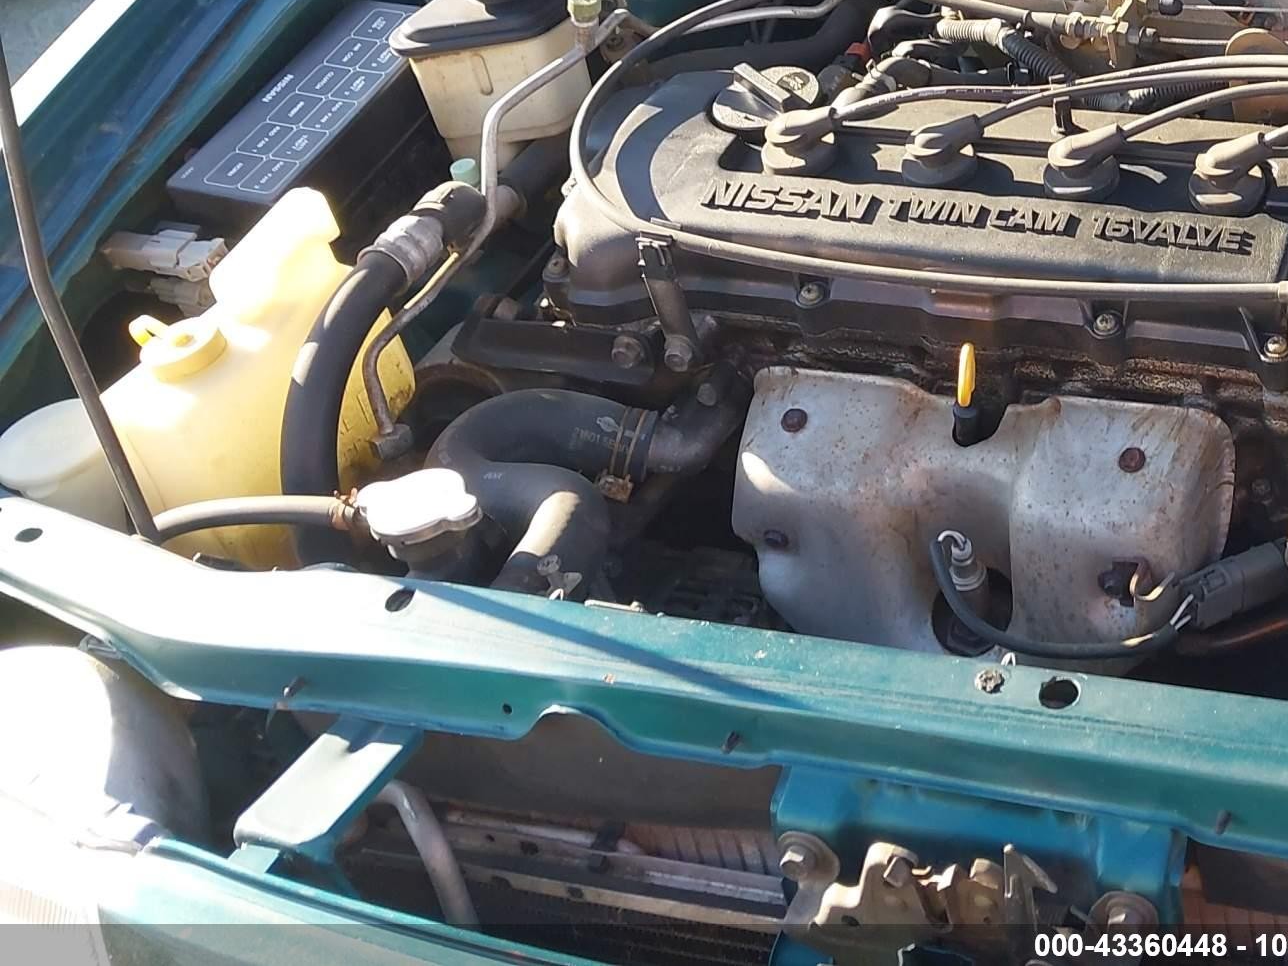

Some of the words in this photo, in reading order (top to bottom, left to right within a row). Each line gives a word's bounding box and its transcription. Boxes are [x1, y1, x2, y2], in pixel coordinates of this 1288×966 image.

[261, 72, 294, 104] NISSAN
[700, 179, 876, 220] NISSAN
[888, 196, 983, 224] TWIN
[988, 207, 1075, 234] CAM
[1094, 216, 1249, 252] 16VALVE
